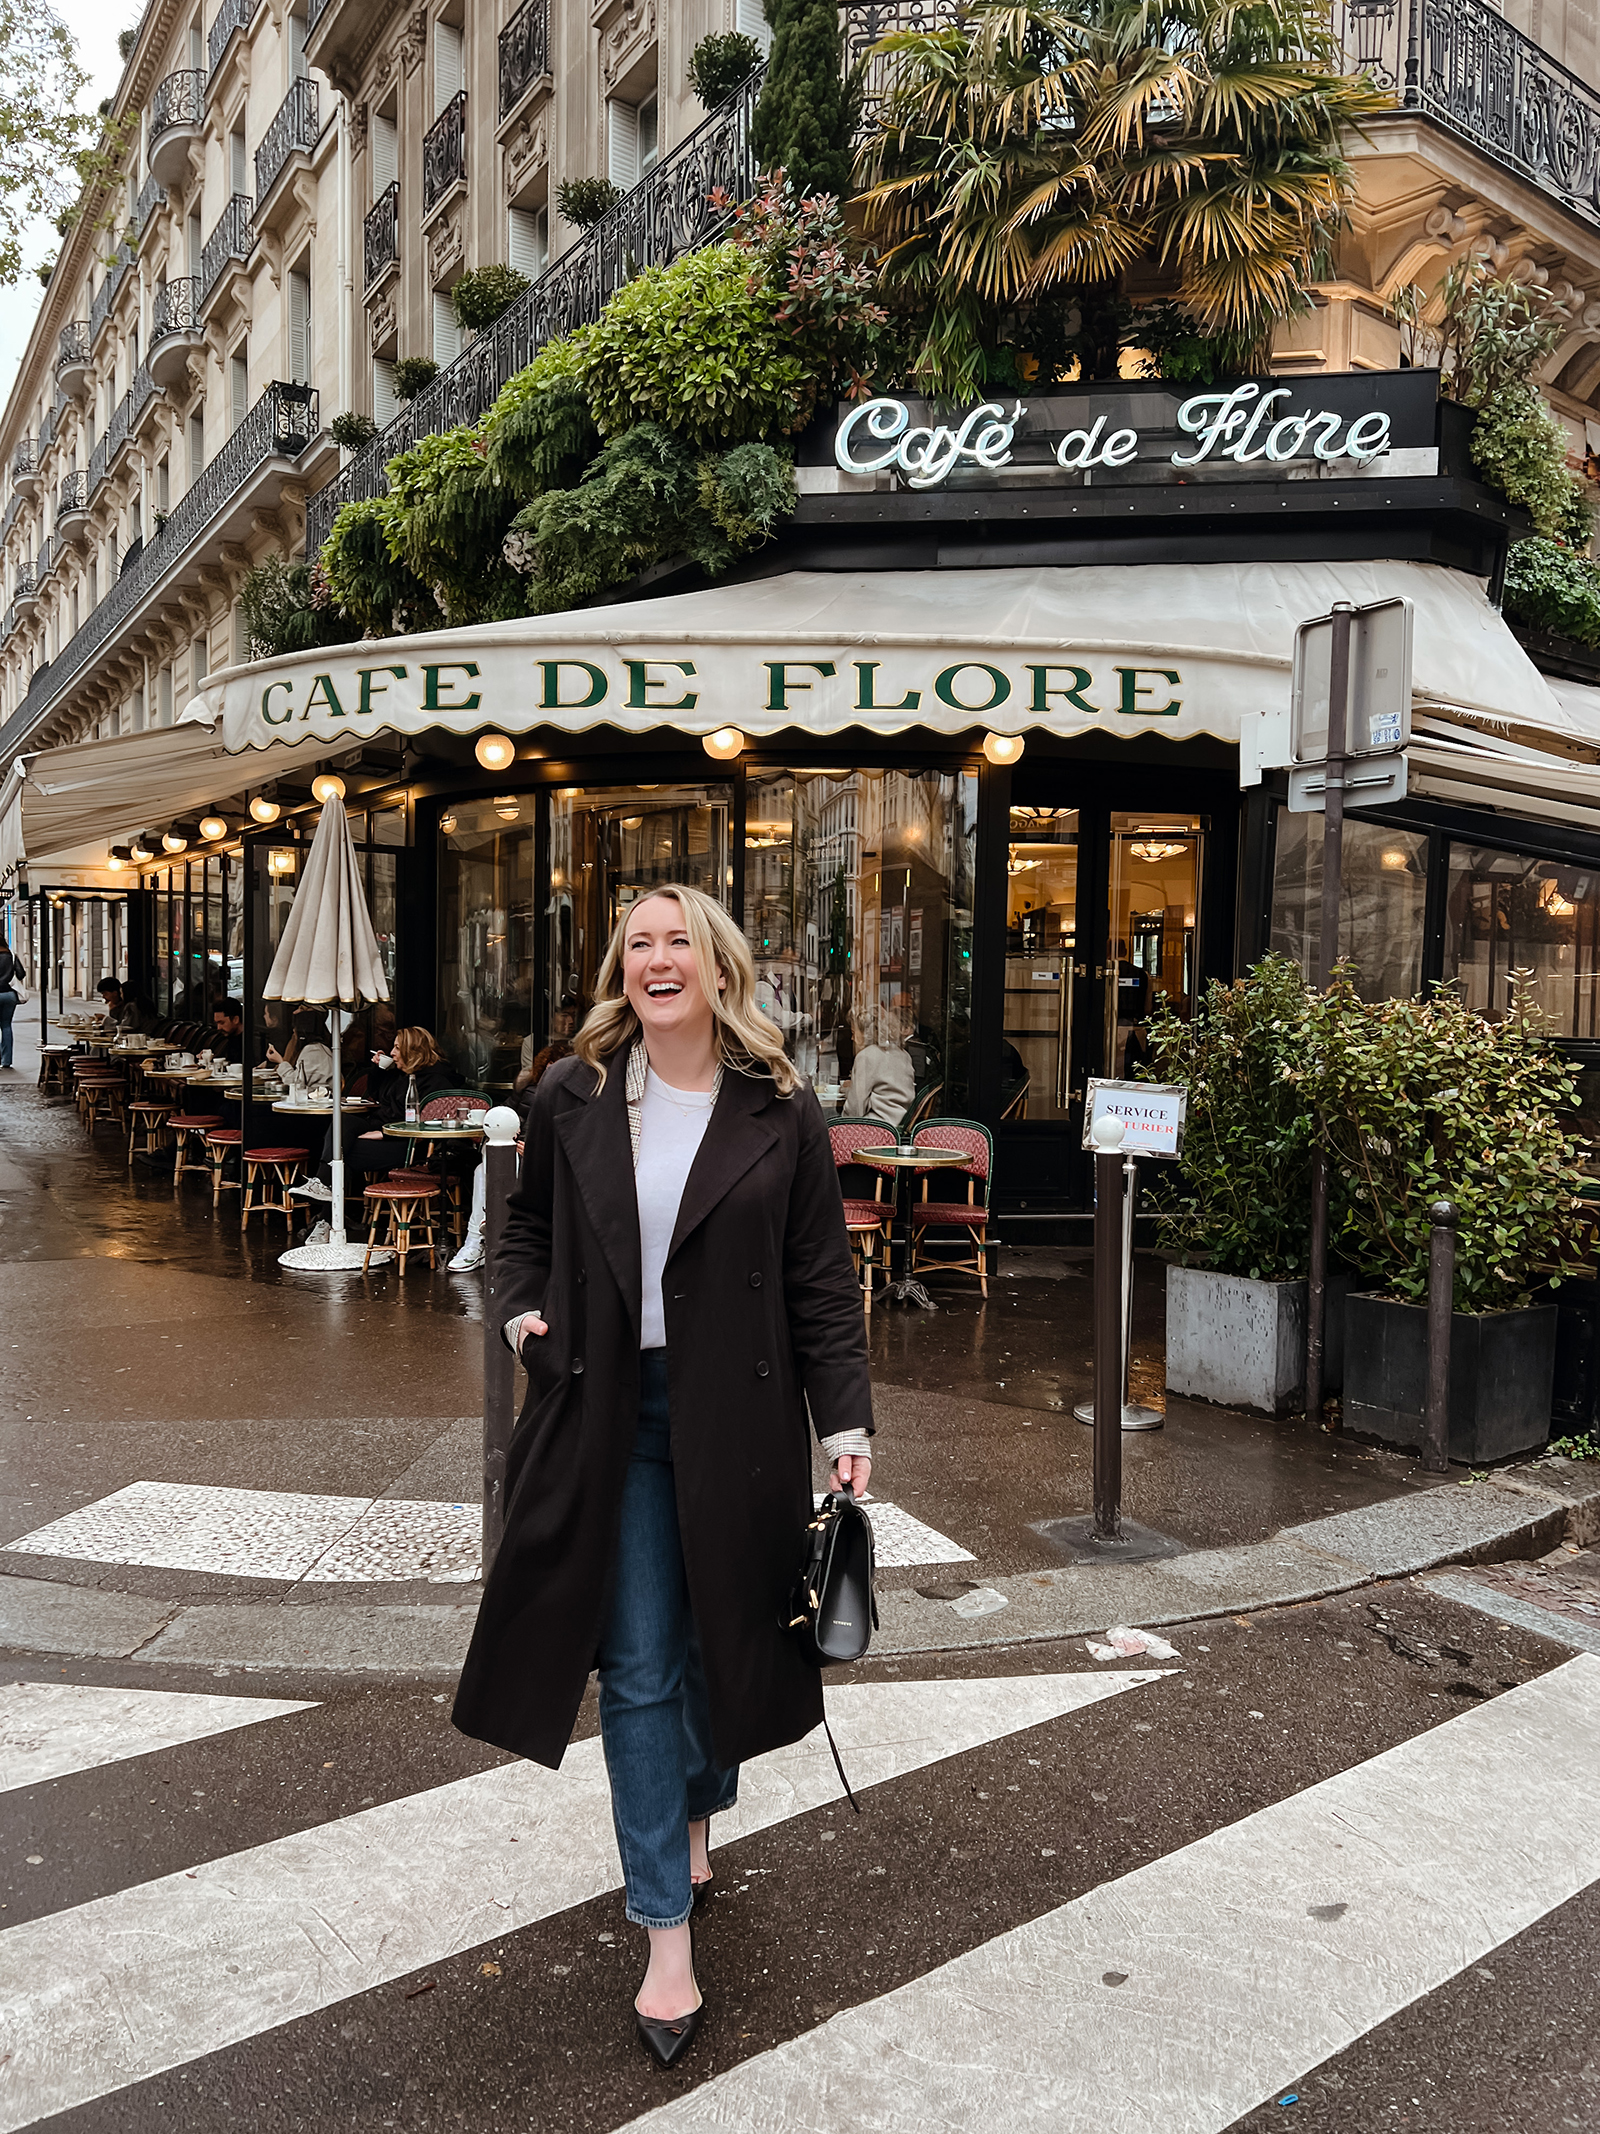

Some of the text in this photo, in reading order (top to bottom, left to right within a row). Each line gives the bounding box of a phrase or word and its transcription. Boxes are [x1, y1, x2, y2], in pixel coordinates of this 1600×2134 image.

[834, 382, 1391, 489] Café de Flore
[261, 658, 1183, 725] CAFE DE FLORE
[1106, 1105, 1168, 1119] SERVICE
[1124, 1121, 1174, 1133] TURIER
